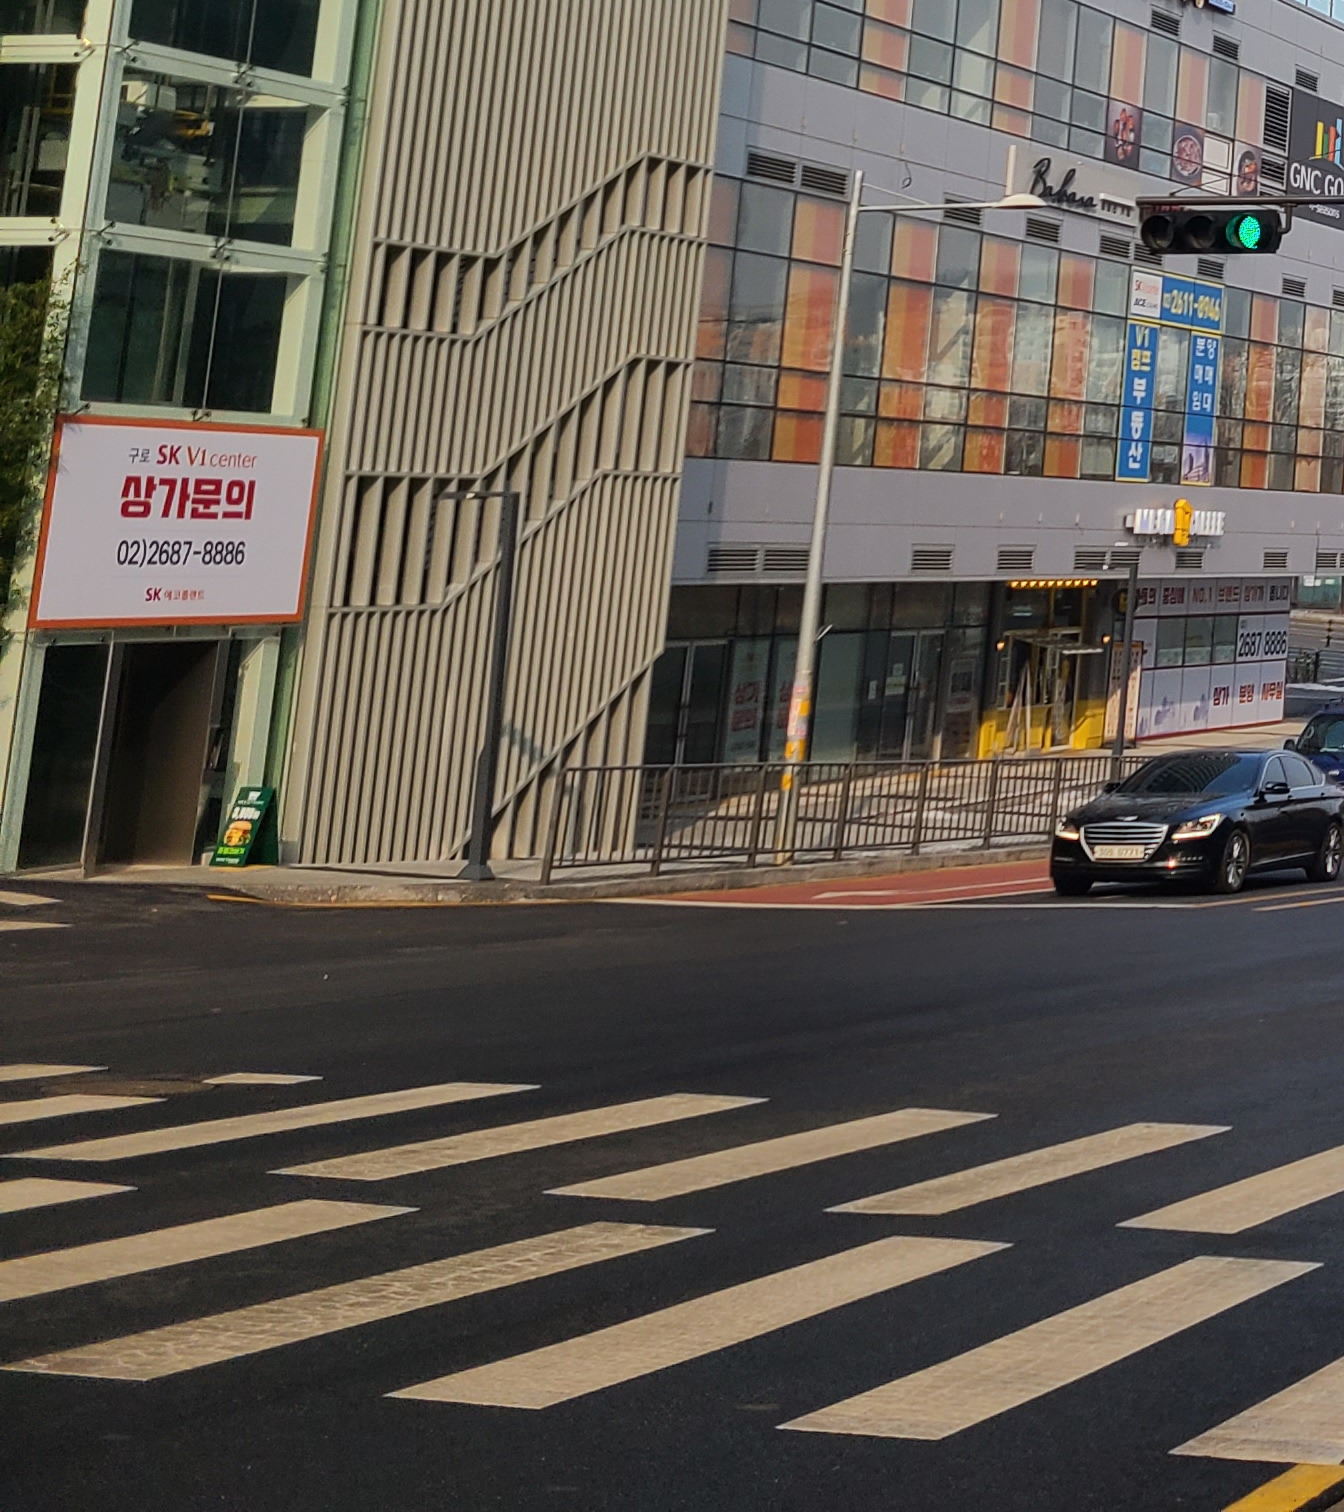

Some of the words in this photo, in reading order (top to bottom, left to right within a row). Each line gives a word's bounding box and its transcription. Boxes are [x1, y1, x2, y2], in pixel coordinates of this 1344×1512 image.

[1290, 162, 1322, 195] GNC
[1135, 325, 1150, 348] V1
[1195, 337, 1217, 360] 분양
[1191, 391, 1213, 412] 임대
[1128, 377, 1148, 469] 부동산
[128, 448, 150, 464] 구로
[156, 444, 182, 465] SK
[187, 446, 206, 466] V1
[209, 452, 258, 469] center
[120, 476, 257, 520] 상가문의
[116, 538, 246, 568] 02)2687-8886
[145, 587, 162, 602] SK
[1238, 631, 1262, 657] 2687
[1263, 630, 1287, 656] 8886
[1213, 686, 1230, 706] 상가
[1238, 683, 1255, 704] 분양
[1260, 681, 1283, 701] 사무실
